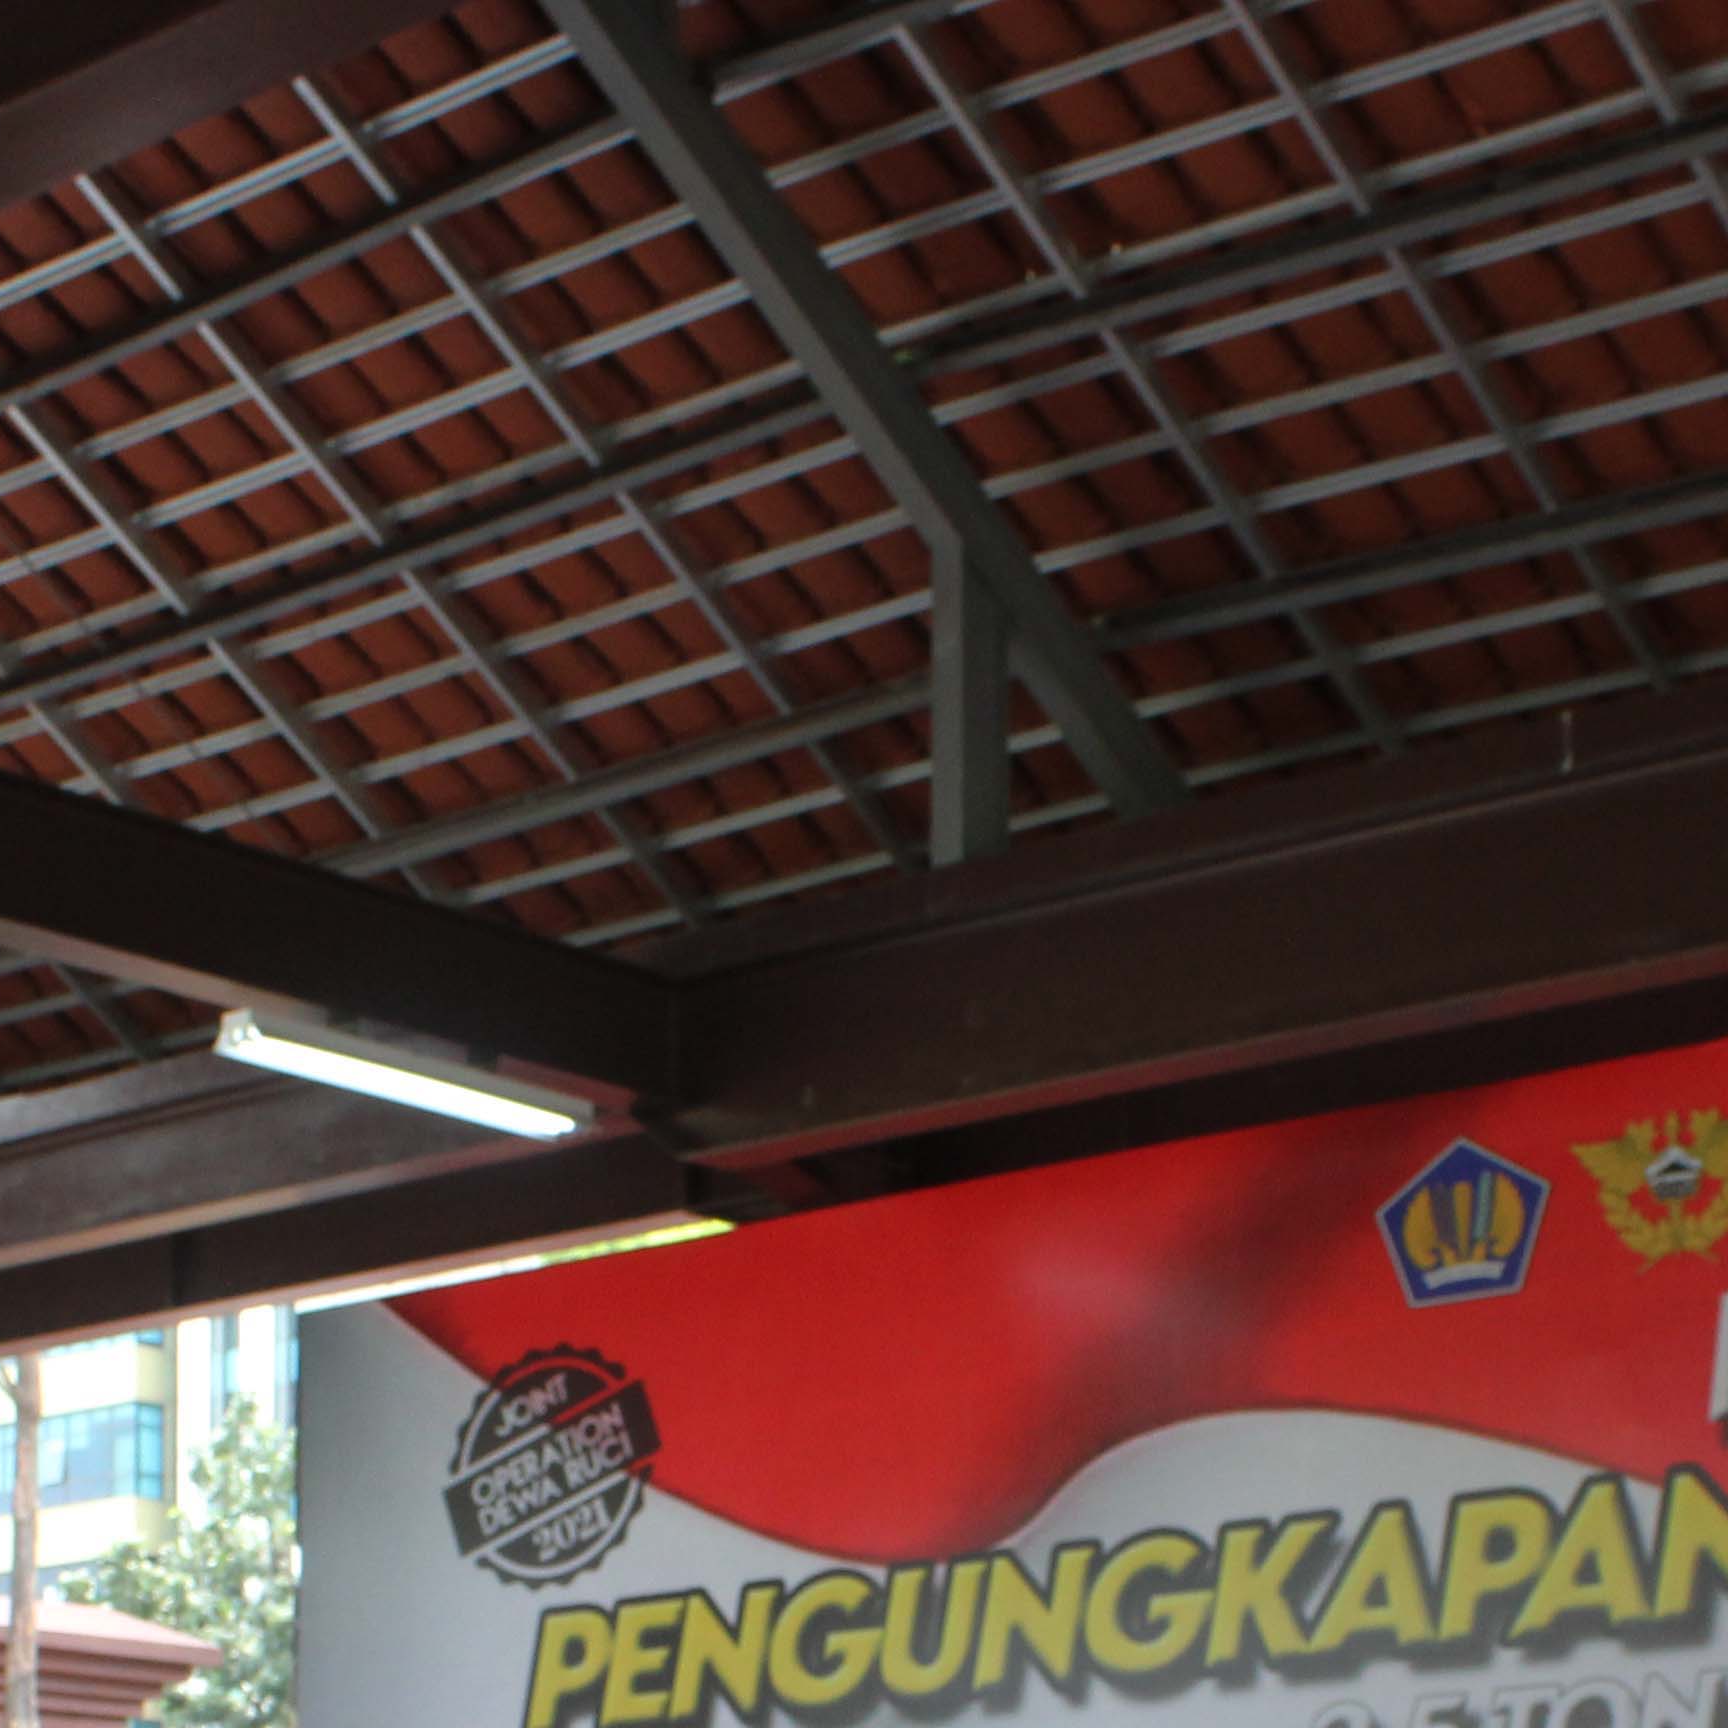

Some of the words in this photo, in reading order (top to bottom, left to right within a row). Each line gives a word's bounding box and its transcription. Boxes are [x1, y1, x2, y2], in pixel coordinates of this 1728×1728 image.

[495, 1373, 568, 1437] JOINT
[473, 1402, 625, 1505] OPERATION
[477, 1479, 563, 1537] DEWA
[532, 1498, 611, 1562] 2021
